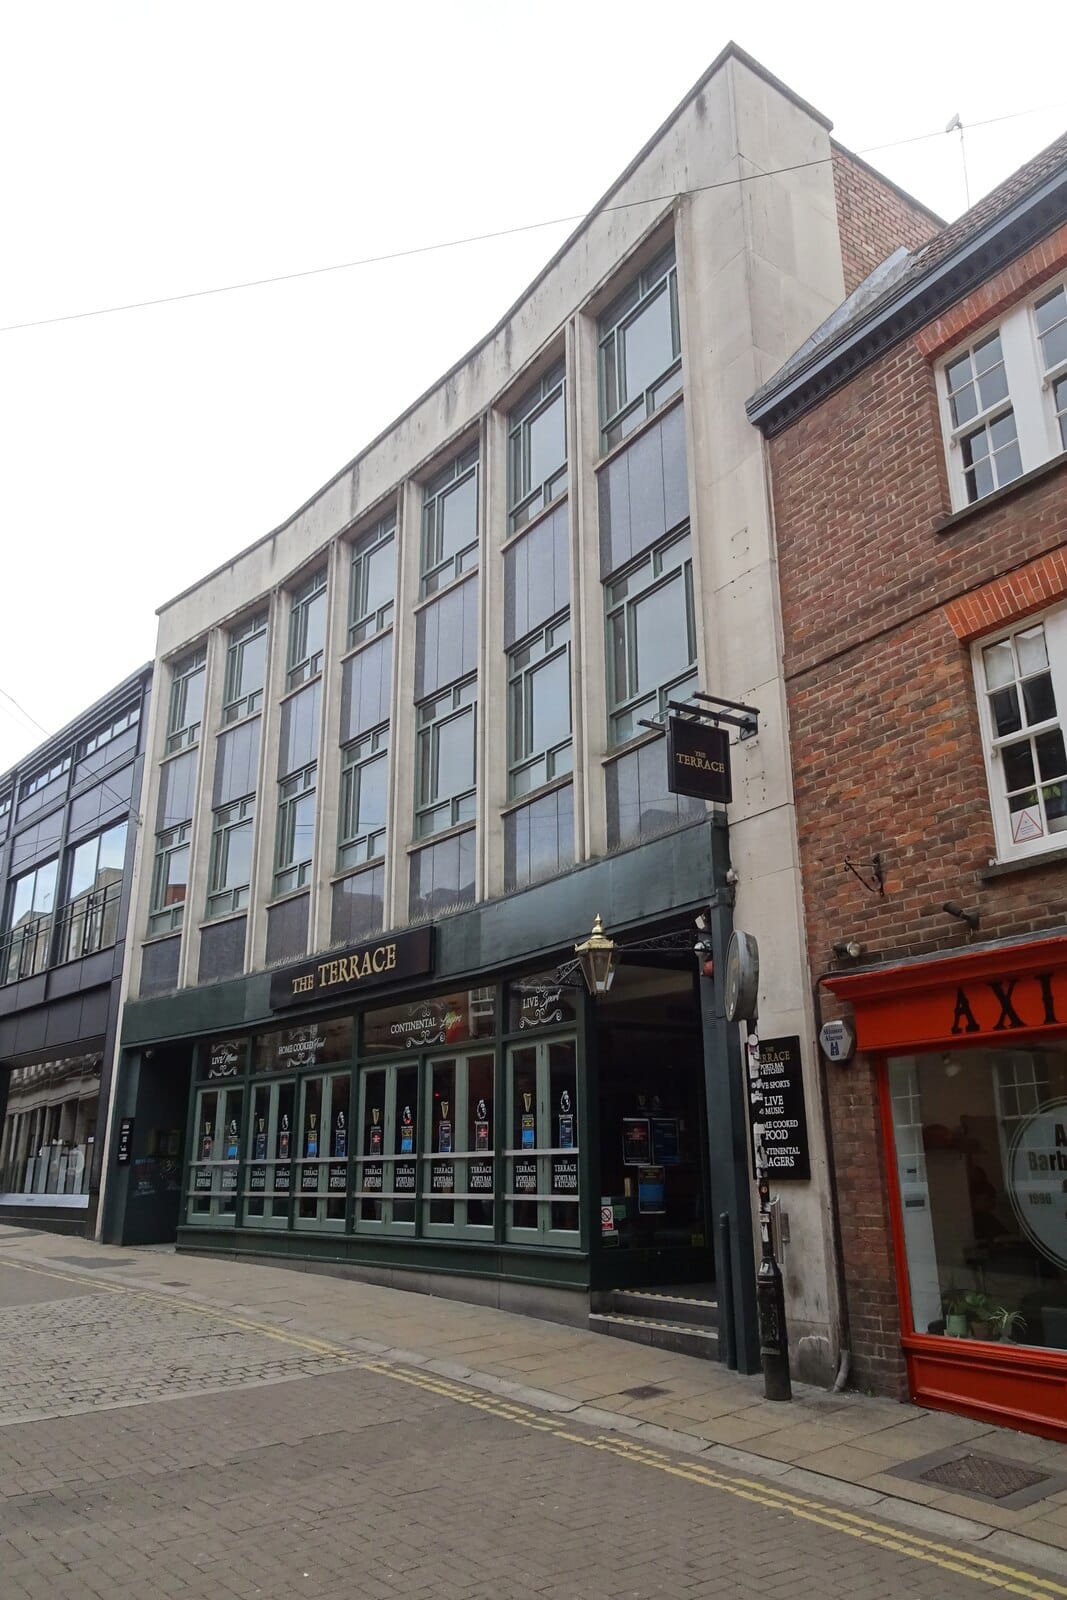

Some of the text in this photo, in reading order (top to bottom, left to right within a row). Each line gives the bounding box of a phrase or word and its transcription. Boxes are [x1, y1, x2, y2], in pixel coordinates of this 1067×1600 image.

[676, 753, 725, 773] TERRACE
[292, 943, 396, 994] THE TERRACE
[523, 996, 539, 1009] LIVE
[951, 972, 1060, 1034] AXI
[390, 1017, 437, 1034] CONTINENTAL
[770, 1080, 791, 1089] SPORTS
[764, 1095, 784, 1106] LIVE
[765, 1106, 784, 1115] MUSIC
[773, 1119, 799, 1128] COOKED
[765, 1129, 789, 1140] FOOD
[766, 1146, 801, 1155] NTINENTAL
[767, 1156, 795, 1167] AGERS
